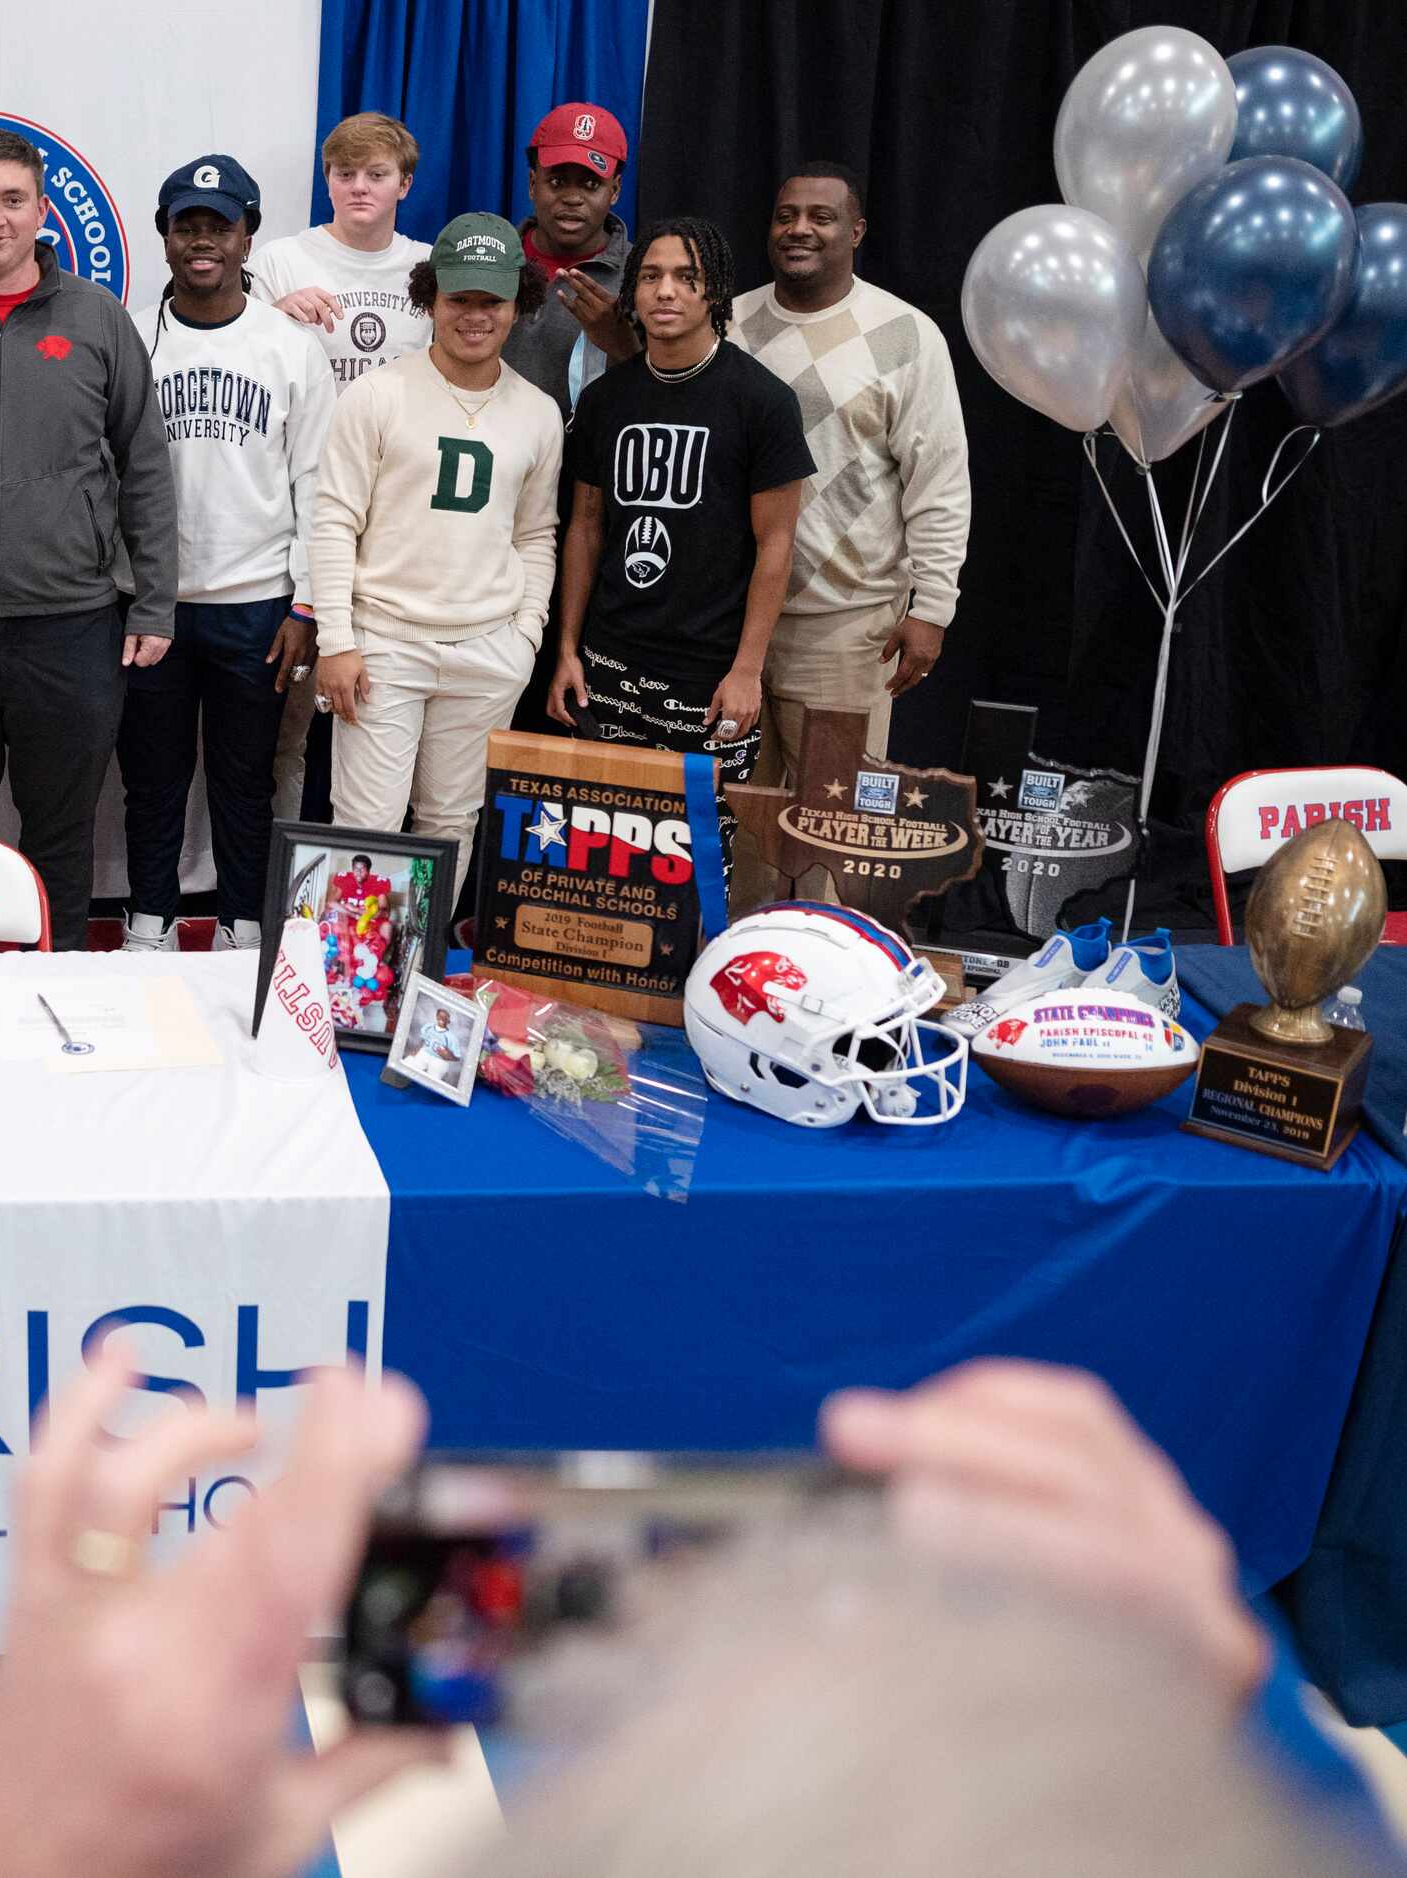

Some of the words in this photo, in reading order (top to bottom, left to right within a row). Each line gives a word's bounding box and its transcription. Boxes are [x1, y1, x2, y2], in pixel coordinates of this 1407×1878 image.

[456, 235, 506, 254] DARTMOUTH
[463, 254, 497, 262] FOOTBALL
[153, 367, 272, 438] ORGETOWN
[166, 418, 250, 446] NIVERSITY
[430, 436, 494, 513] D
[613, 423, 710, 509] OBU
[861, 776, 895, 789] BUILT
[1026, 775, 1059, 788] BUILT
[510, 778, 563, 797] TEXAS
[567, 787, 686, 815] ASSOCIATION
[859, 798, 891, 809] TOUGH
[1023, 796, 1056, 808] TOUGH
[799, 807, 834, 819] TEXAS
[835, 810, 859, 822] HIGH
[861, 814, 897, 826] SCHOOL
[898, 818, 948, 832] FOOTBALL
[976, 808, 997, 817] XAS
[998, 809, 1023, 821] HIGH
[1024, 812, 1062, 825] SCHOOL
[1062, 817, 1112, 832] FOOTBALL
[1258, 797, 1392, 839] PARISH
[494, 793, 694, 886] TAPPS
[797, 817, 870, 846] PLAYER
[874, 826, 885, 836] OF
[890, 827, 949, 848] WEEK
[985, 818, 1034, 844] AYER
[1039, 824, 1051, 835] OF
[1052, 825, 1109, 848] YEAR
[870, 837, 887, 848] THE
[1035, 835, 1053, 847] THE
[843, 860, 902, 879] 2020
[1001, 857, 1061, 877] 2020
[521, 869, 543, 883] OF
[546, 874, 617, 895] PRIVATE
[619, 884, 657, 901] AND
[497, 880, 591, 908] PAROCHIAL
[595, 894, 679, 920] SCHOOLS
[545, 912, 571, 925] 2019
[577, 917, 625, 934] Football
[521, 921, 559, 939] State
[563, 927, 645, 953] Champion
[556, 941, 599, 957] Division
[485, 949, 583, 979] Competition
[586, 961, 621, 983] with
[625, 970, 677, 992] Honor
[1033, 1004, 1074, 1023] STATE
[1040, 1027, 1080, 1038] PARISH
[1083, 1027, 1139, 1040] EPISCOPAL
[1040, 1038, 1069, 1048] JOHN
[1072, 1037, 1099, 1048] PAUL
[1248, 1067, 1291, 1088] TAPPS
[1233, 1080, 1287, 1103] Division
[1202, 1088, 1256, 1111] REGIONAL
[1259, 1103, 1324, 1130] CHAMPIONS
[1210, 1105, 1261, 1126] November
